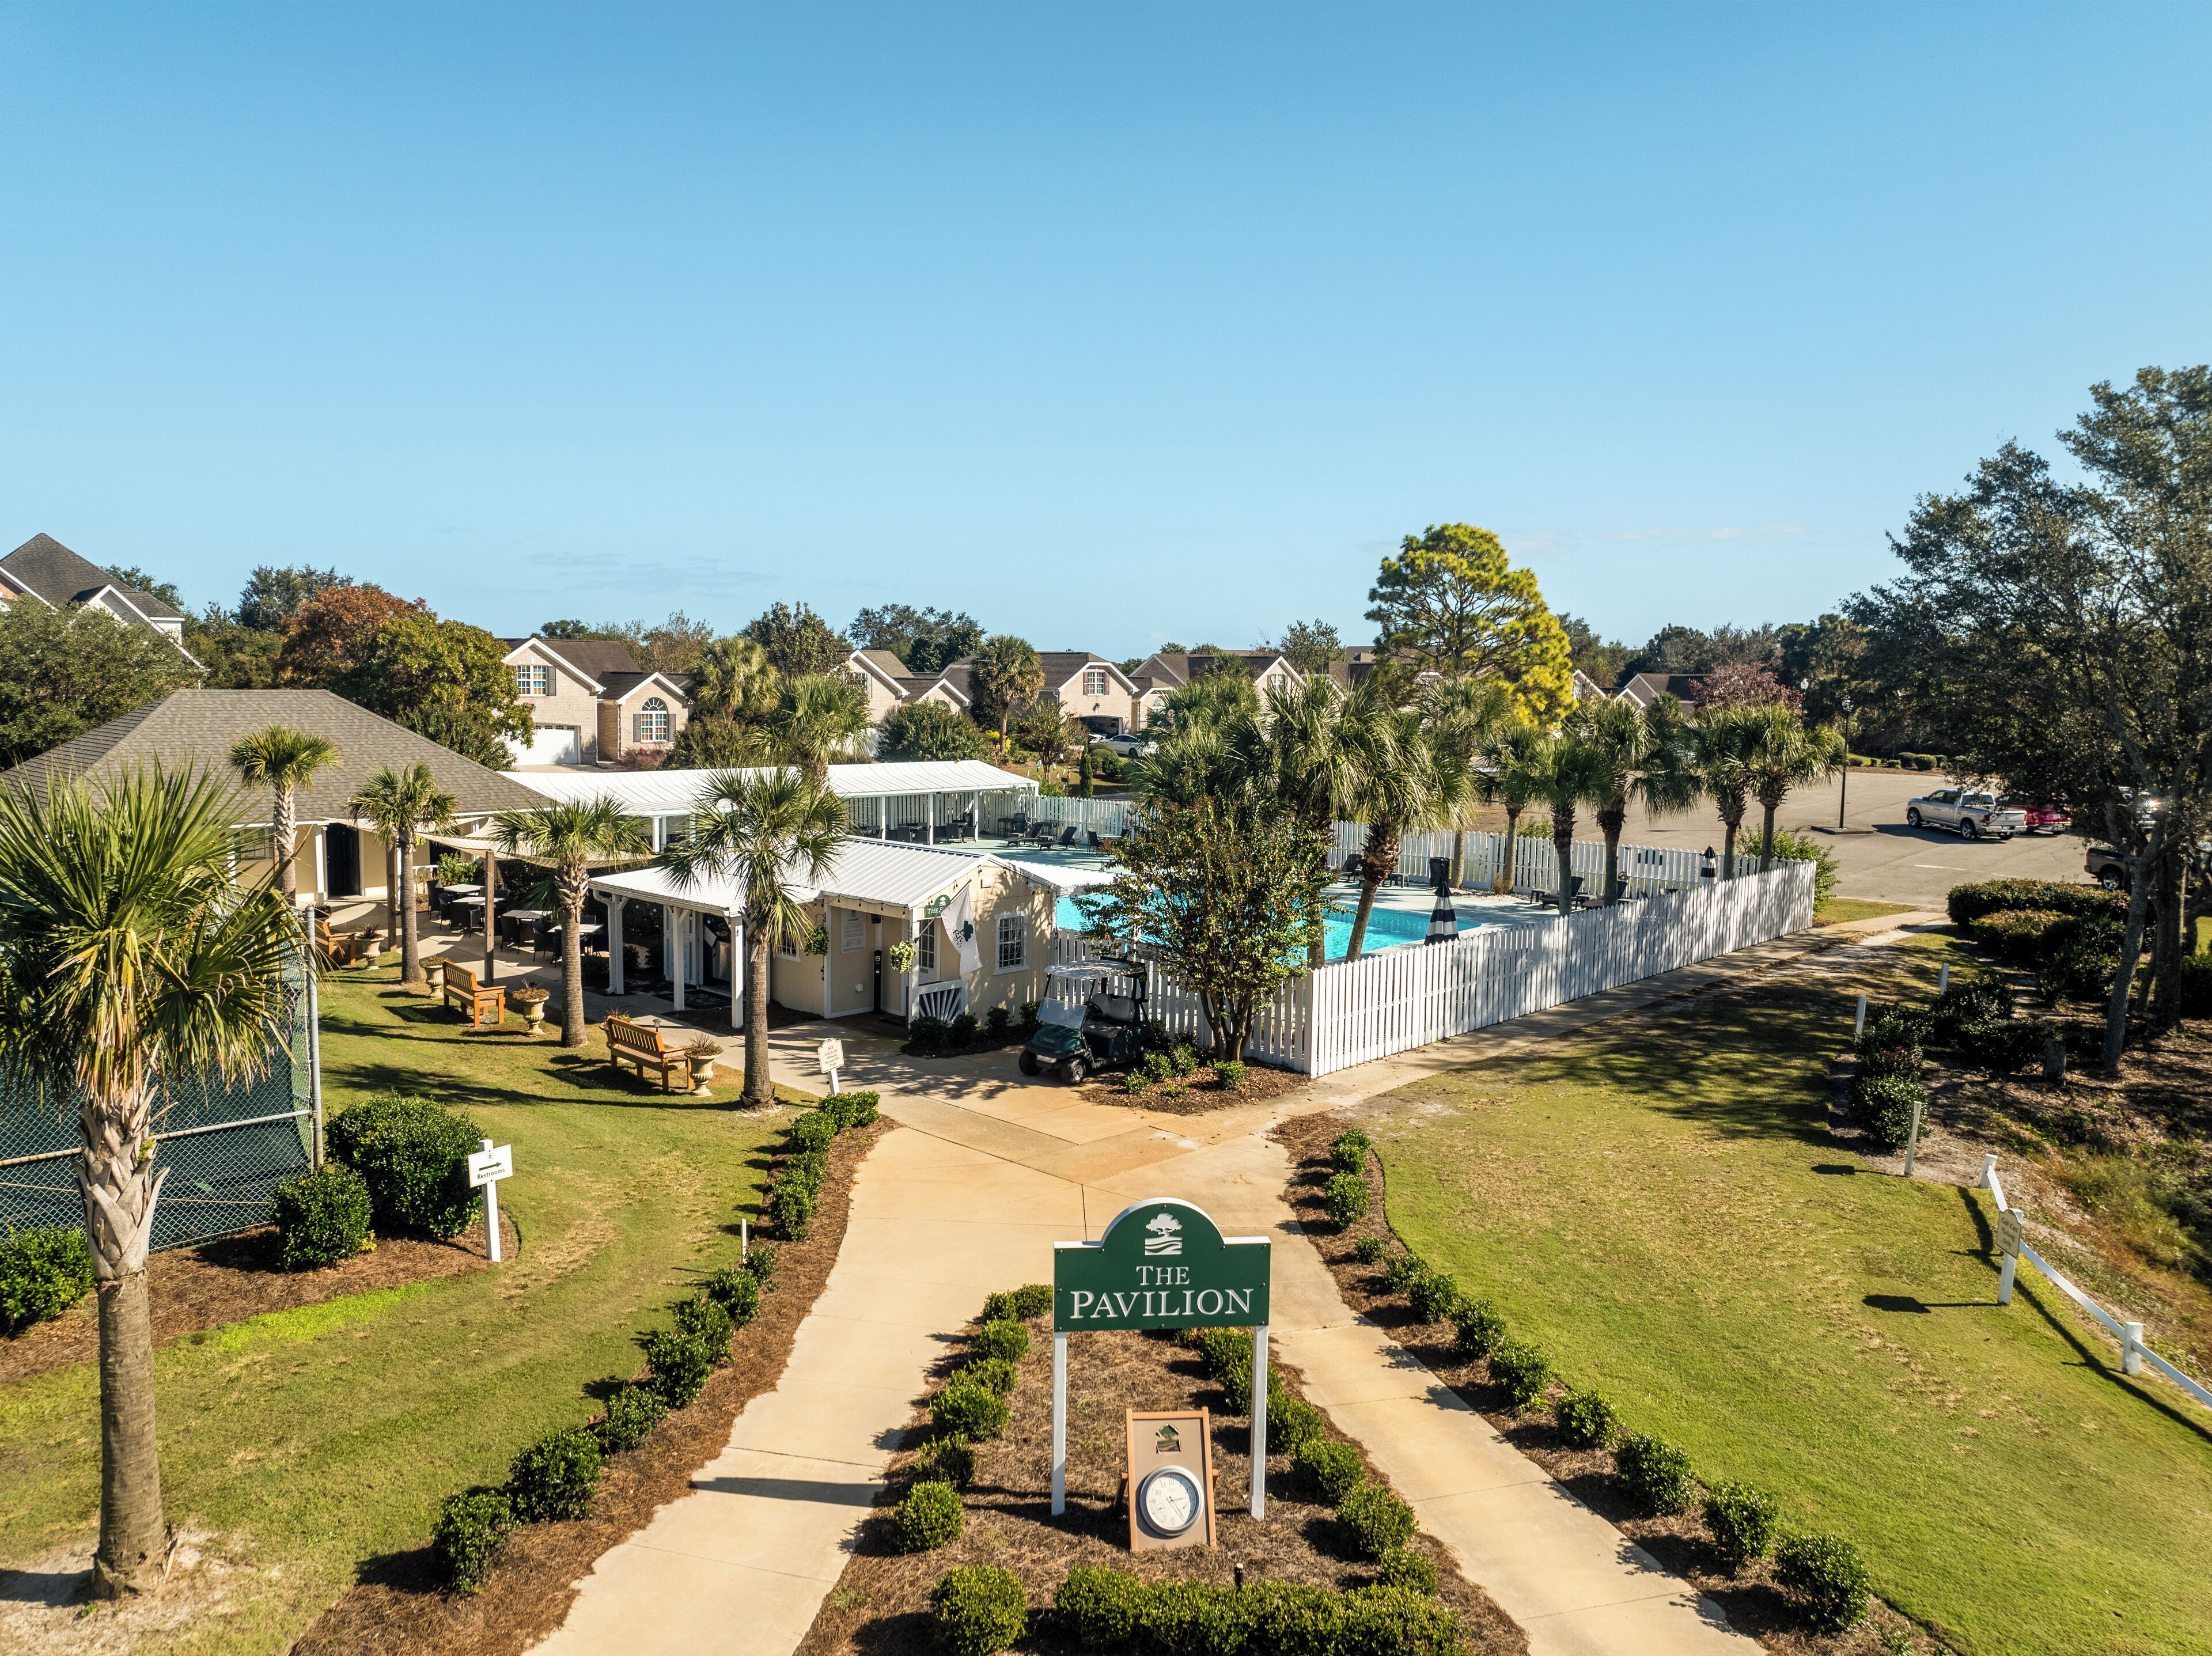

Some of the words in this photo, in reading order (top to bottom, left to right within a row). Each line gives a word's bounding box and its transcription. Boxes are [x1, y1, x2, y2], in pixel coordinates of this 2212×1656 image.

[477, 1168, 505, 1180] Restrooms
[2001, 1217, 2010, 1226] Golf
[2009, 1223, 2018, 1233] Cart
[2002, 1227, 2015, 1242] Parking
[2002, 1237, 2011, 1249] Only
[1136, 1265, 1190, 1286] THE
[1070, 1288, 1254, 1319] PAVILION
